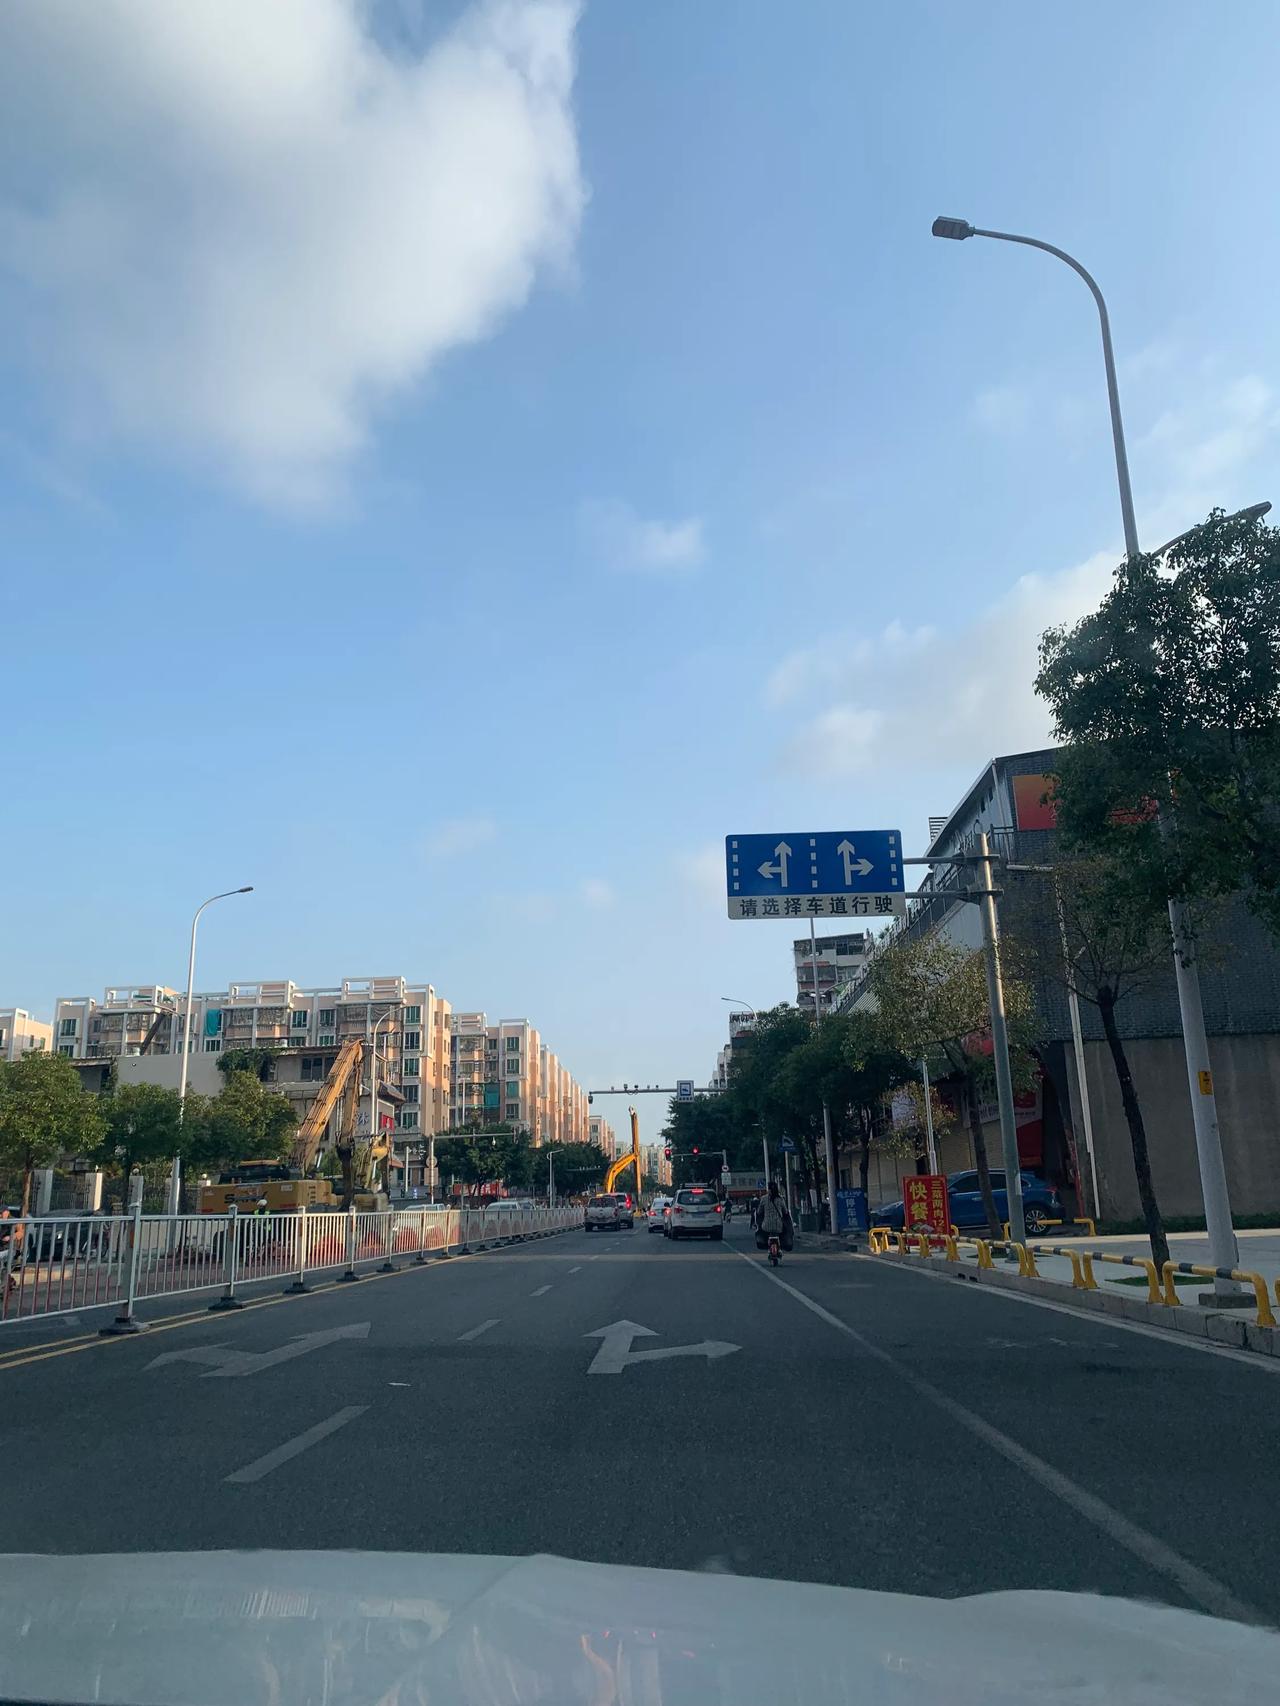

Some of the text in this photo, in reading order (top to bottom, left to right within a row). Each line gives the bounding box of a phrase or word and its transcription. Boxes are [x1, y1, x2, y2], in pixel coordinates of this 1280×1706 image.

[740, 895, 893, 916] 请选择车道行驶
[910, 1181, 928, 1220] 快餐
